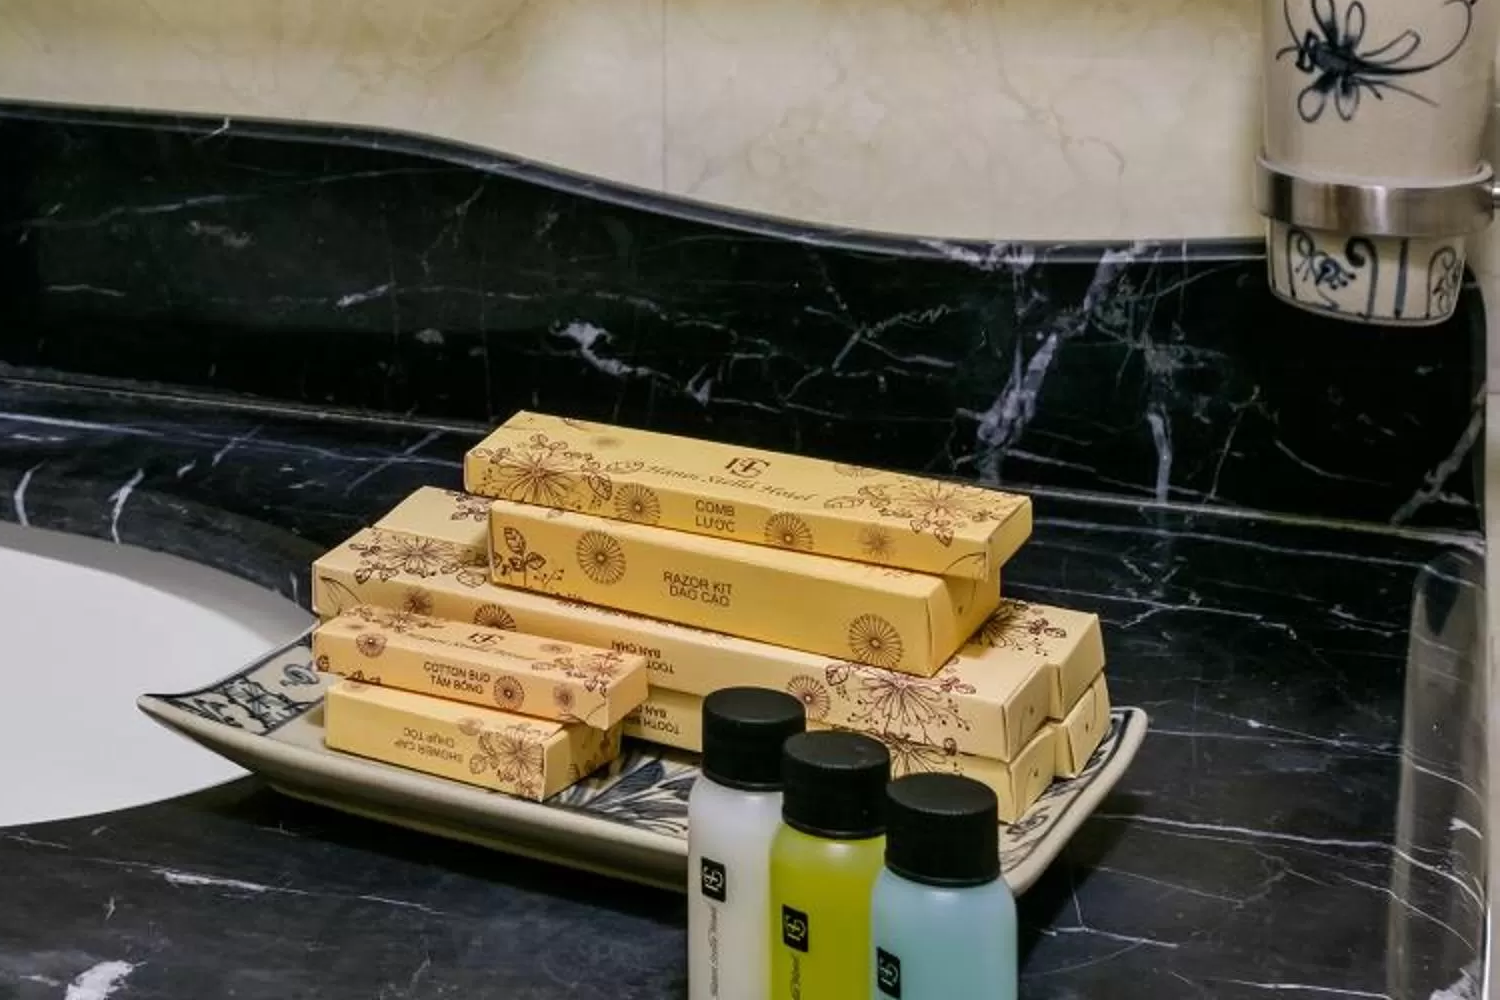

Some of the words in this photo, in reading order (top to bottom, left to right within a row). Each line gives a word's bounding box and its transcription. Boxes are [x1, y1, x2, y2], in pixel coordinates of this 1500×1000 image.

[695, 499, 735, 517] COMB
[663, 571, 709, 590] RAZOR
[712, 583, 732, 595] KIT
[423, 660, 467, 678] COTTON
[645, 660, 675, 675] TOOT
